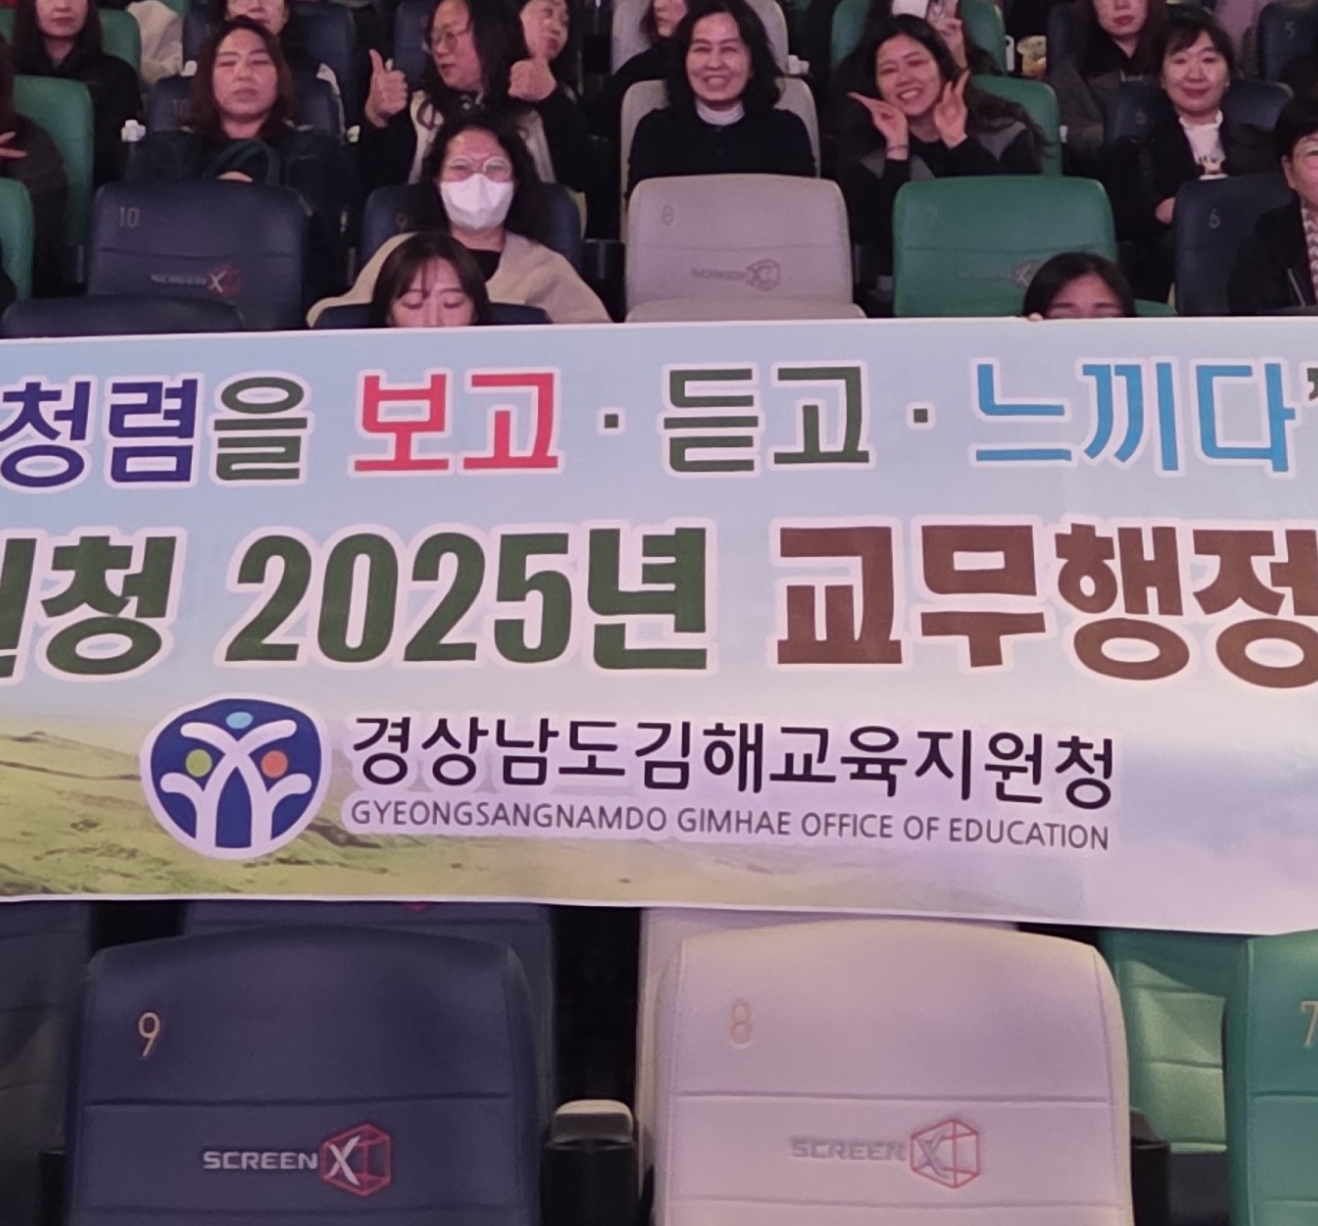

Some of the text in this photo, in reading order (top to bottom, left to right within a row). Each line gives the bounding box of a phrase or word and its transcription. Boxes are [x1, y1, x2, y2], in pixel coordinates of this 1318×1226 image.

[1284, 21, 1296, 39] 5
[118, 206, 140, 229] 10
[660, 204, 675, 226] 8
[1207, 206, 1222, 229] 6
[354, 371, 560, 473] 보고
[663, 364, 871, 473] 듣고
[223, 526, 708, 671] 2025년
[352, 715, 1114, 811] 경상남도김해교육지원청
[350, 799, 1110, 851] GYEONGSANGNAMDO GIMHAE OFFICE OF EDUCATION
[137, 1011, 161, 1058] 9
[728, 998, 753, 1045] 8
